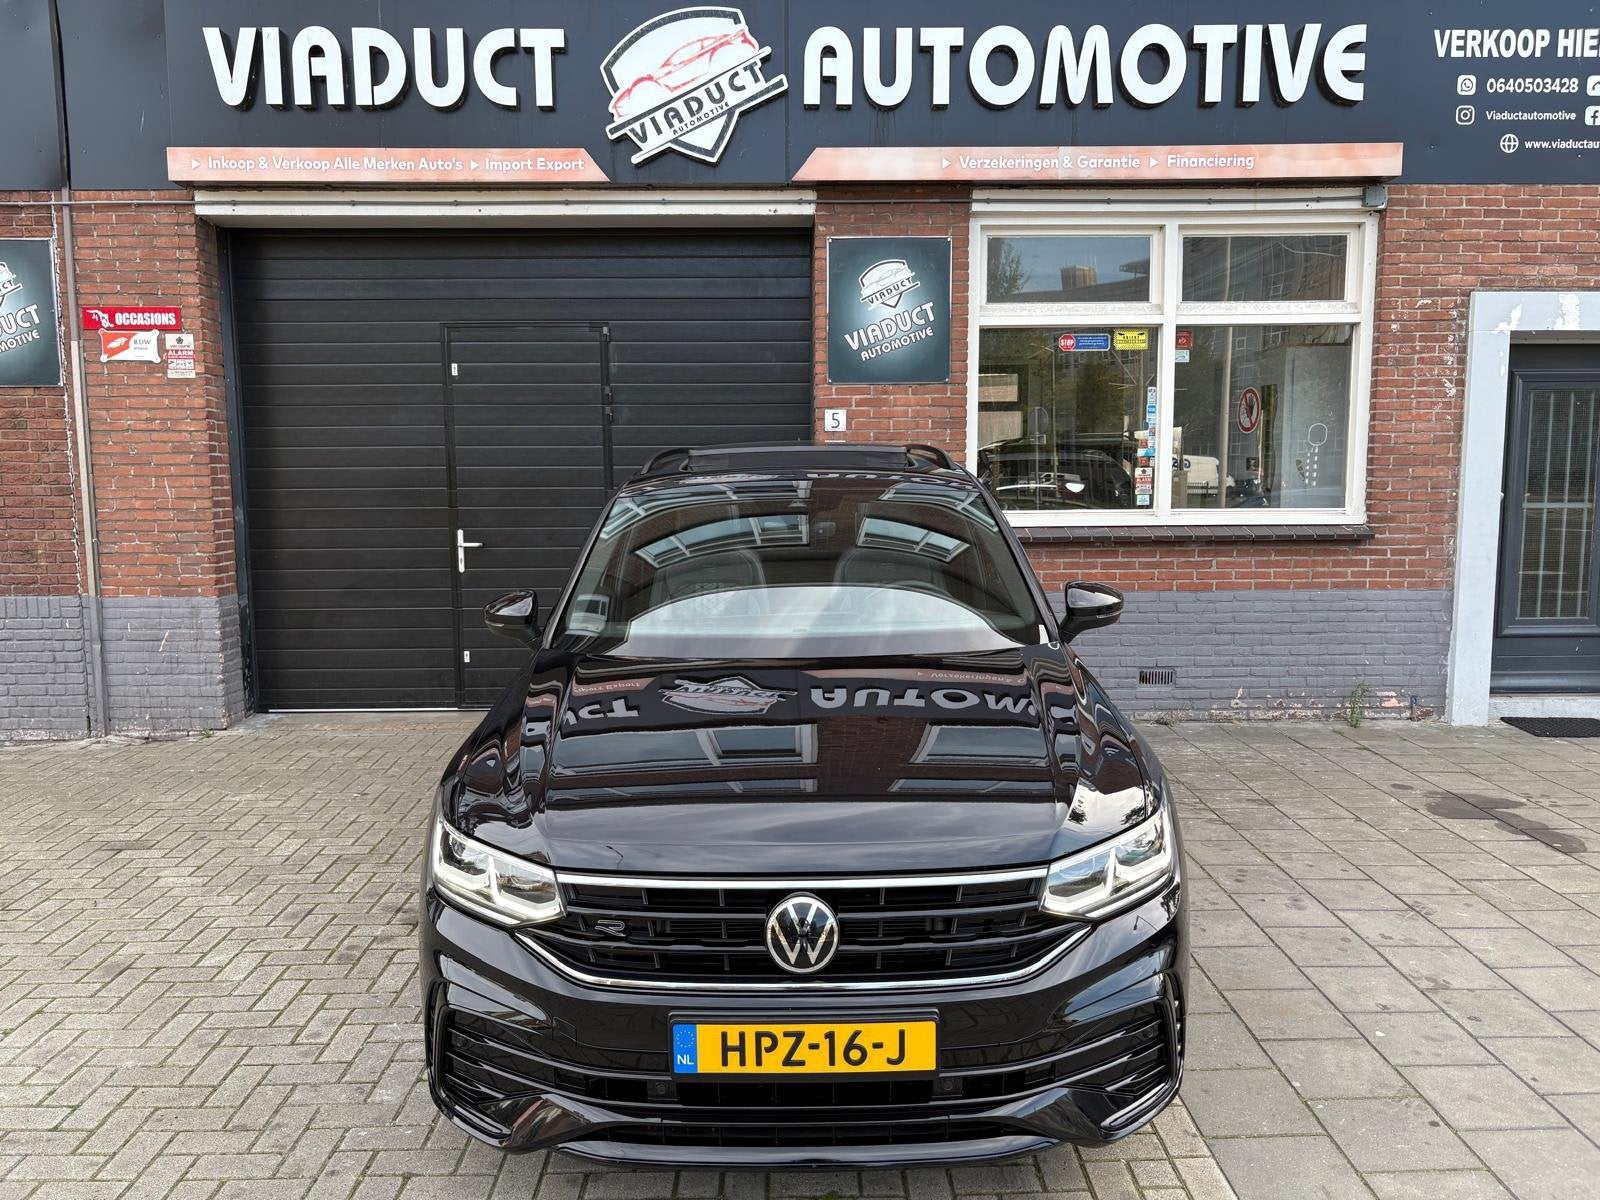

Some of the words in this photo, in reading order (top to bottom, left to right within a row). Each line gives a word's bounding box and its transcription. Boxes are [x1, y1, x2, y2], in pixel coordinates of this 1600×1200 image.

[1434, 29, 1550, 57] VERKOOP
[1557, 29, 1600, 57] HIE
[202, 26, 565, 107] VIADUCT
[803, 23, 1367, 106] AUTOMOTIVE
[1486, 78, 1579, 93] 0640503428
[629, 61, 761, 143] VIADUCT
[672, 101, 730, 135] AUTOMOTIVE
[1486, 110, 1576, 121] Viaductautomotive
[208, 156, 255, 172] Inkoop
[258, 157, 269, 170] &
[272, 156, 331, 172] Verkoop
[333, 156, 360, 170] Alle
[363, 156, 415, 170] Merken
[418, 157, 464, 171] Auto's
[485, 157, 534, 174] Import
[536, 157, 585, 174] Export
[959, 155, 1059, 171] Verzekeringen
[1062, 156, 1073, 169] &
[1078, 154, 1141, 169] Garantie
[1167, 154, 1255, 170] Financiering
[868, 277, 912, 304] VIADUCT
[0, 304, 40, 335] UCT
[115, 312, 176, 326] OCCASIONS
[843, 302, 935, 351] VIADUCT
[860, 326, 934, 361] AUTOMOTIVE
[1060, 339, 1074, 347] STOP
[831, 412, 840, 429] 5
[720, 1028, 906, 1067] HPZ-16-J
[677, 1055, 694, 1065] NL
